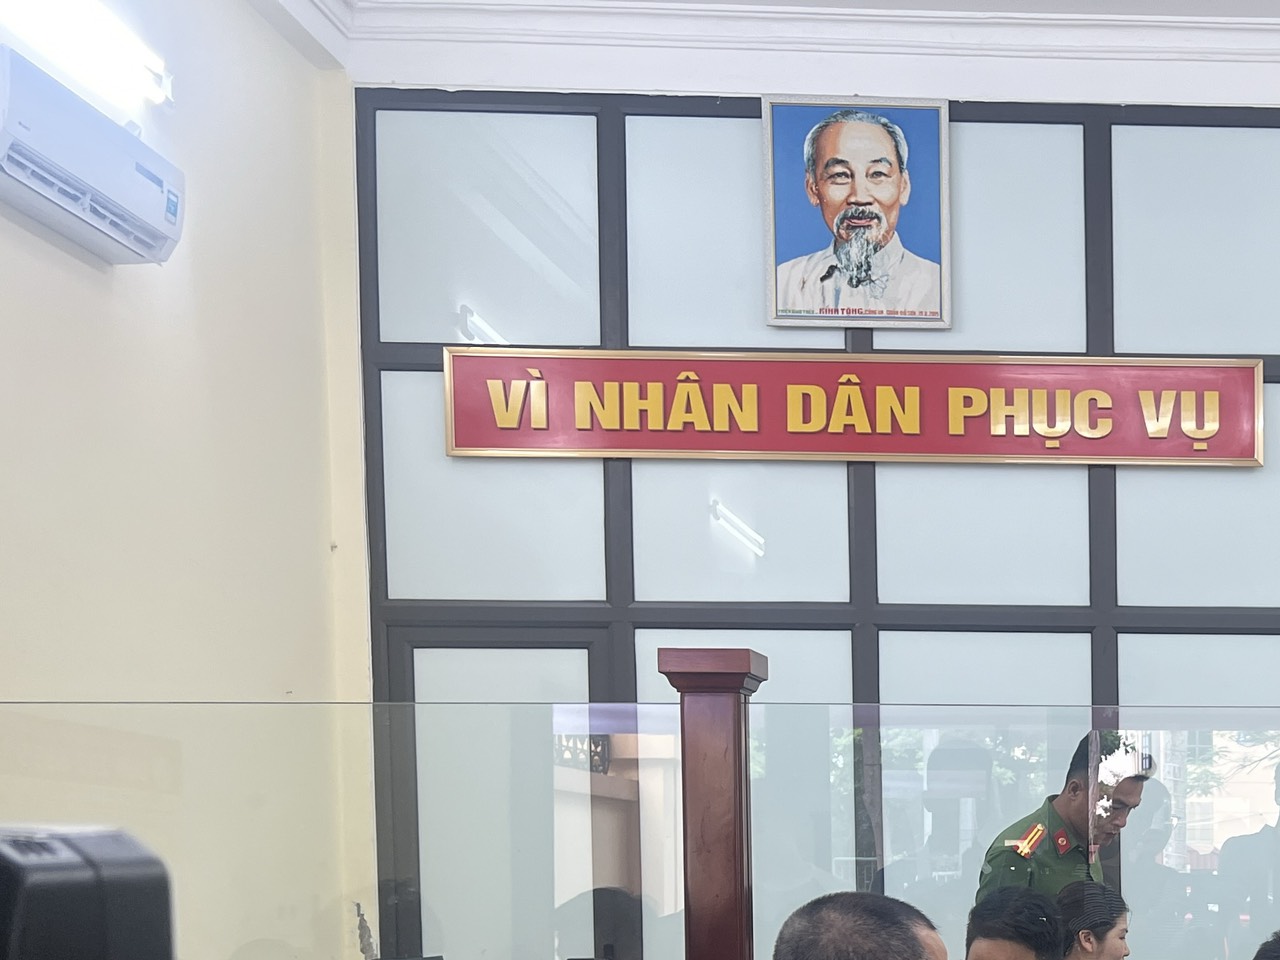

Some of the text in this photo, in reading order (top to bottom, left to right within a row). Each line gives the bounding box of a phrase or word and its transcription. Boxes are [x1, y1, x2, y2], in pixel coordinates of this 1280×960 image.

[486, 368, 1220, 452] VÌ NHÂN DÂN PHỤC VỤ
